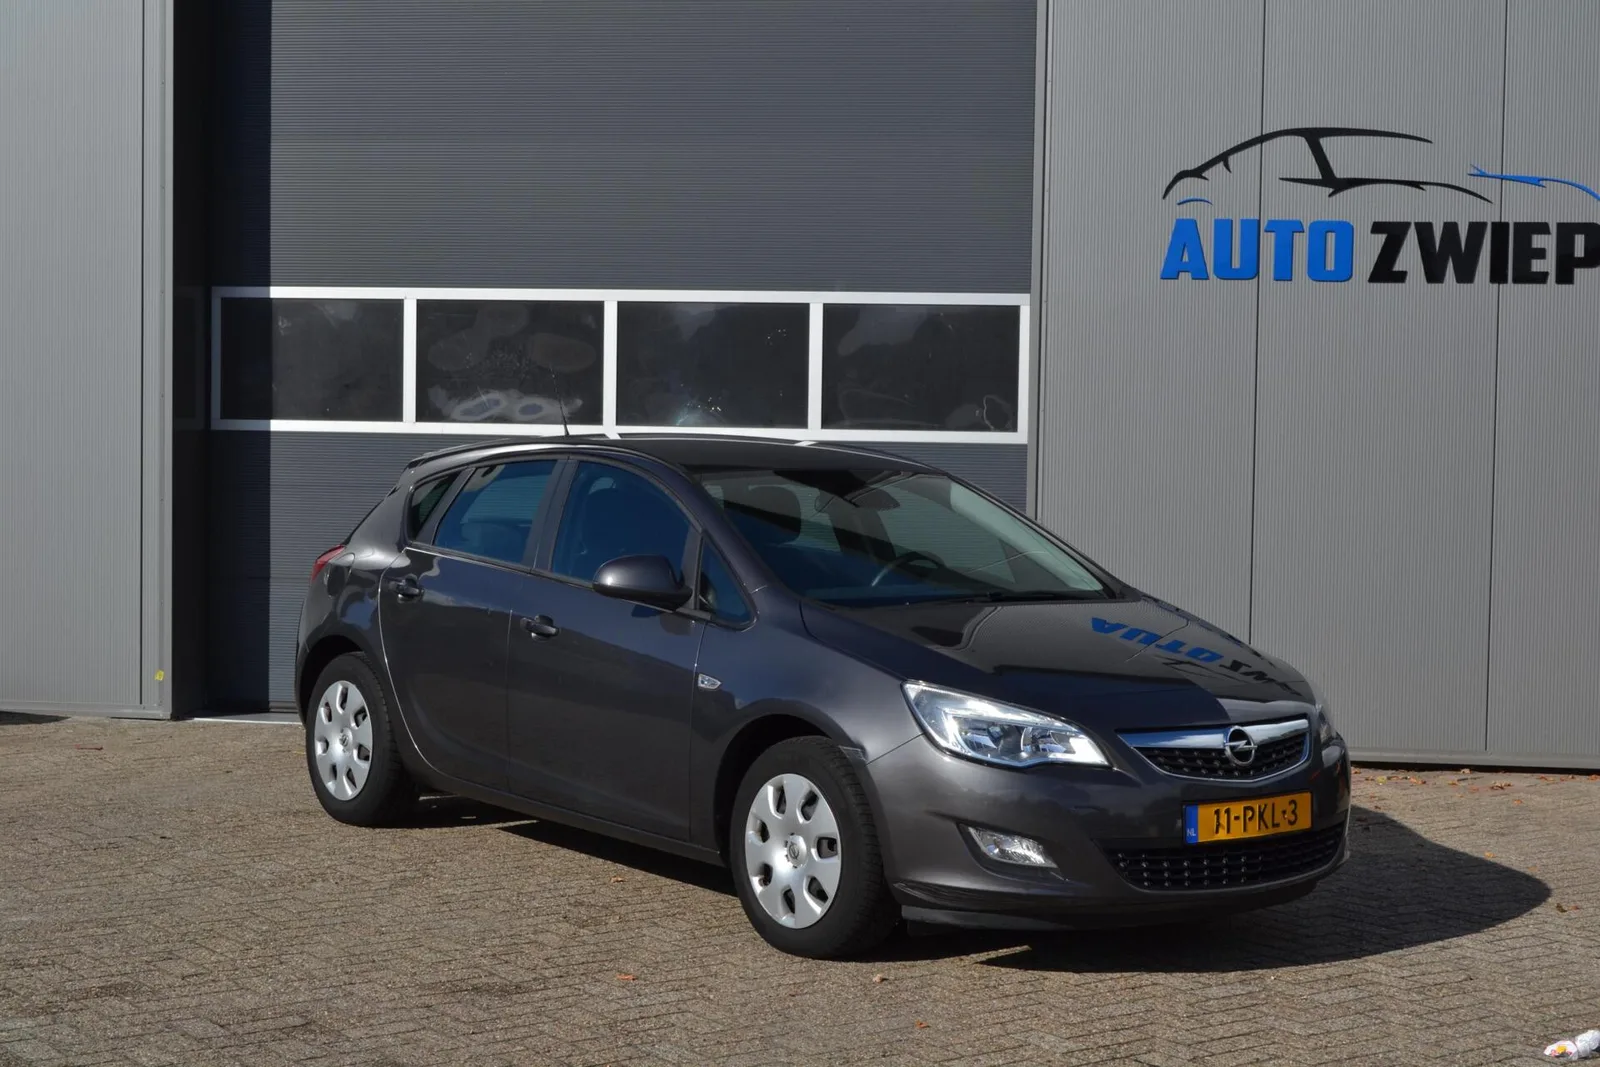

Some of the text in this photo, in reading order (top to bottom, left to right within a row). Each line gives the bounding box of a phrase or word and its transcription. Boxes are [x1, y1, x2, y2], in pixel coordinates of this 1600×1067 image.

[1160, 218, 1600, 285] AUTO ZWIEP
[1186, 799, 1298, 837] NL 11-PKL-3
